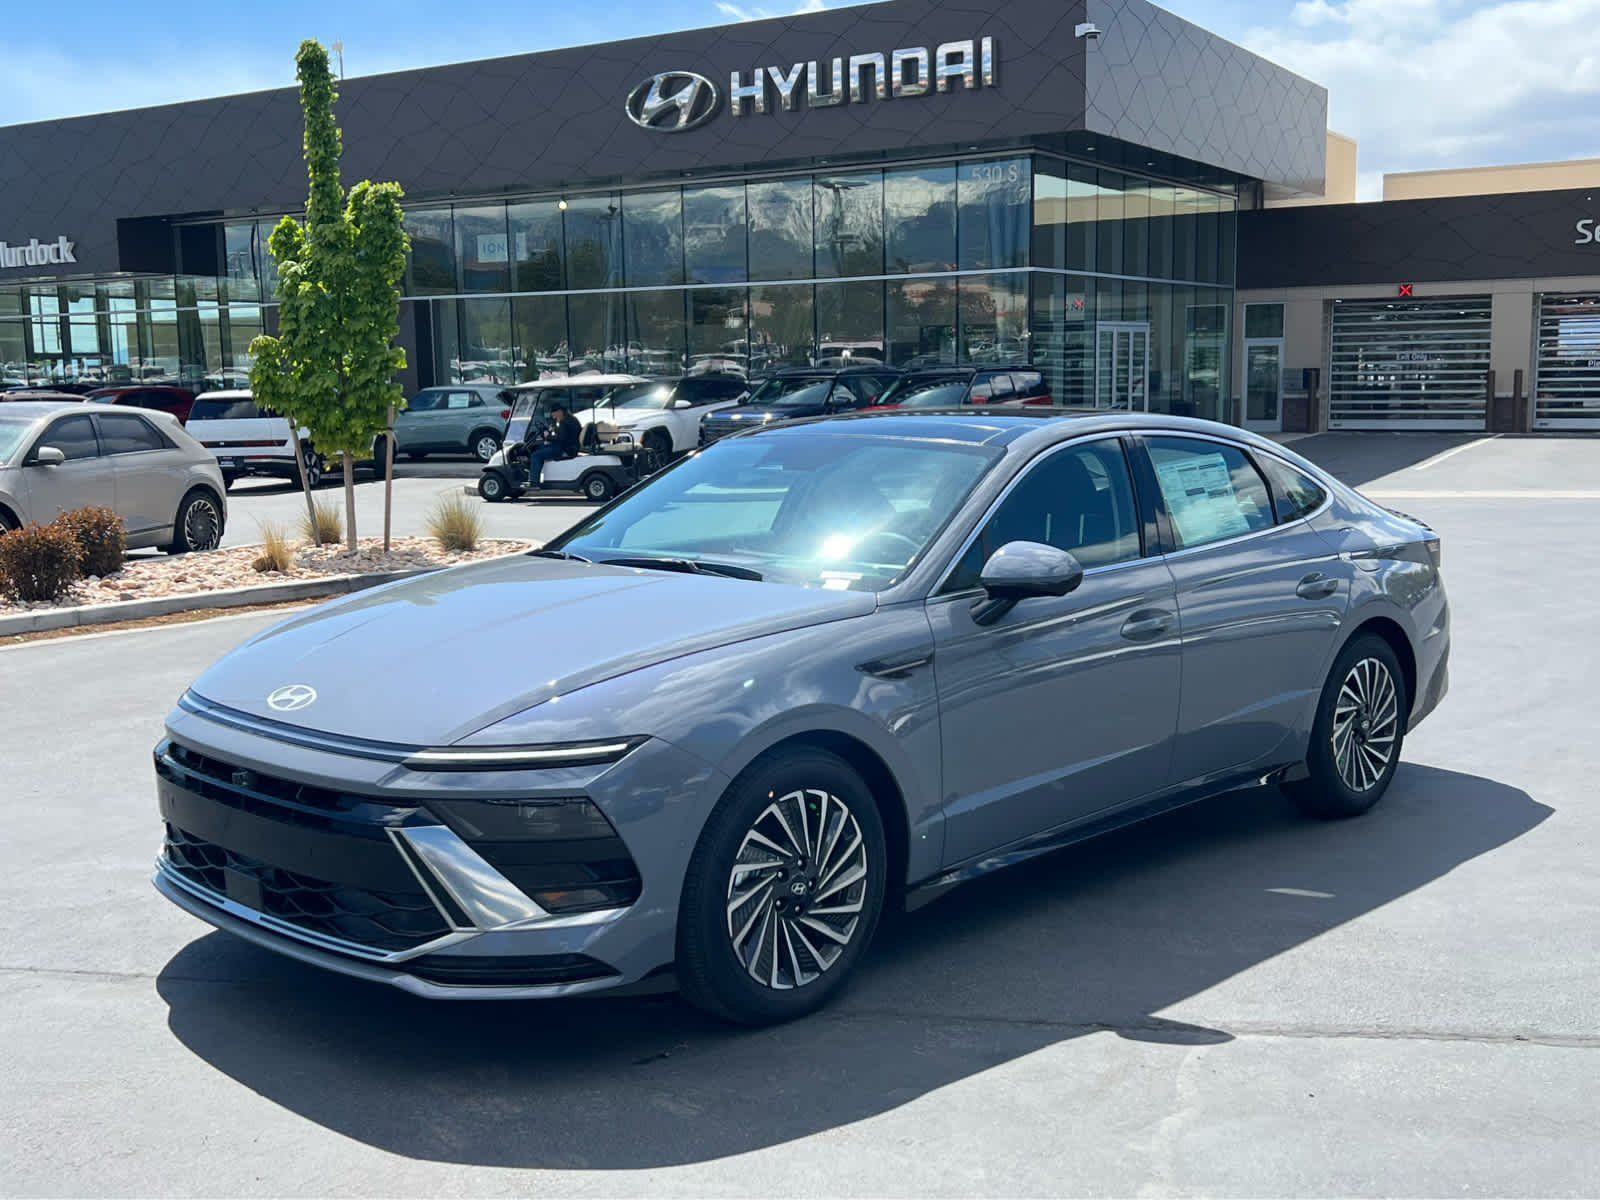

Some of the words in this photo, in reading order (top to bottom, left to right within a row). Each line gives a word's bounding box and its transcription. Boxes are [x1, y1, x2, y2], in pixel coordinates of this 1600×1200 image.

[730, 36, 994, 116] HYUNDAI
[972, 165, 1003, 184] 530
[1007, 164, 1018, 182] S
